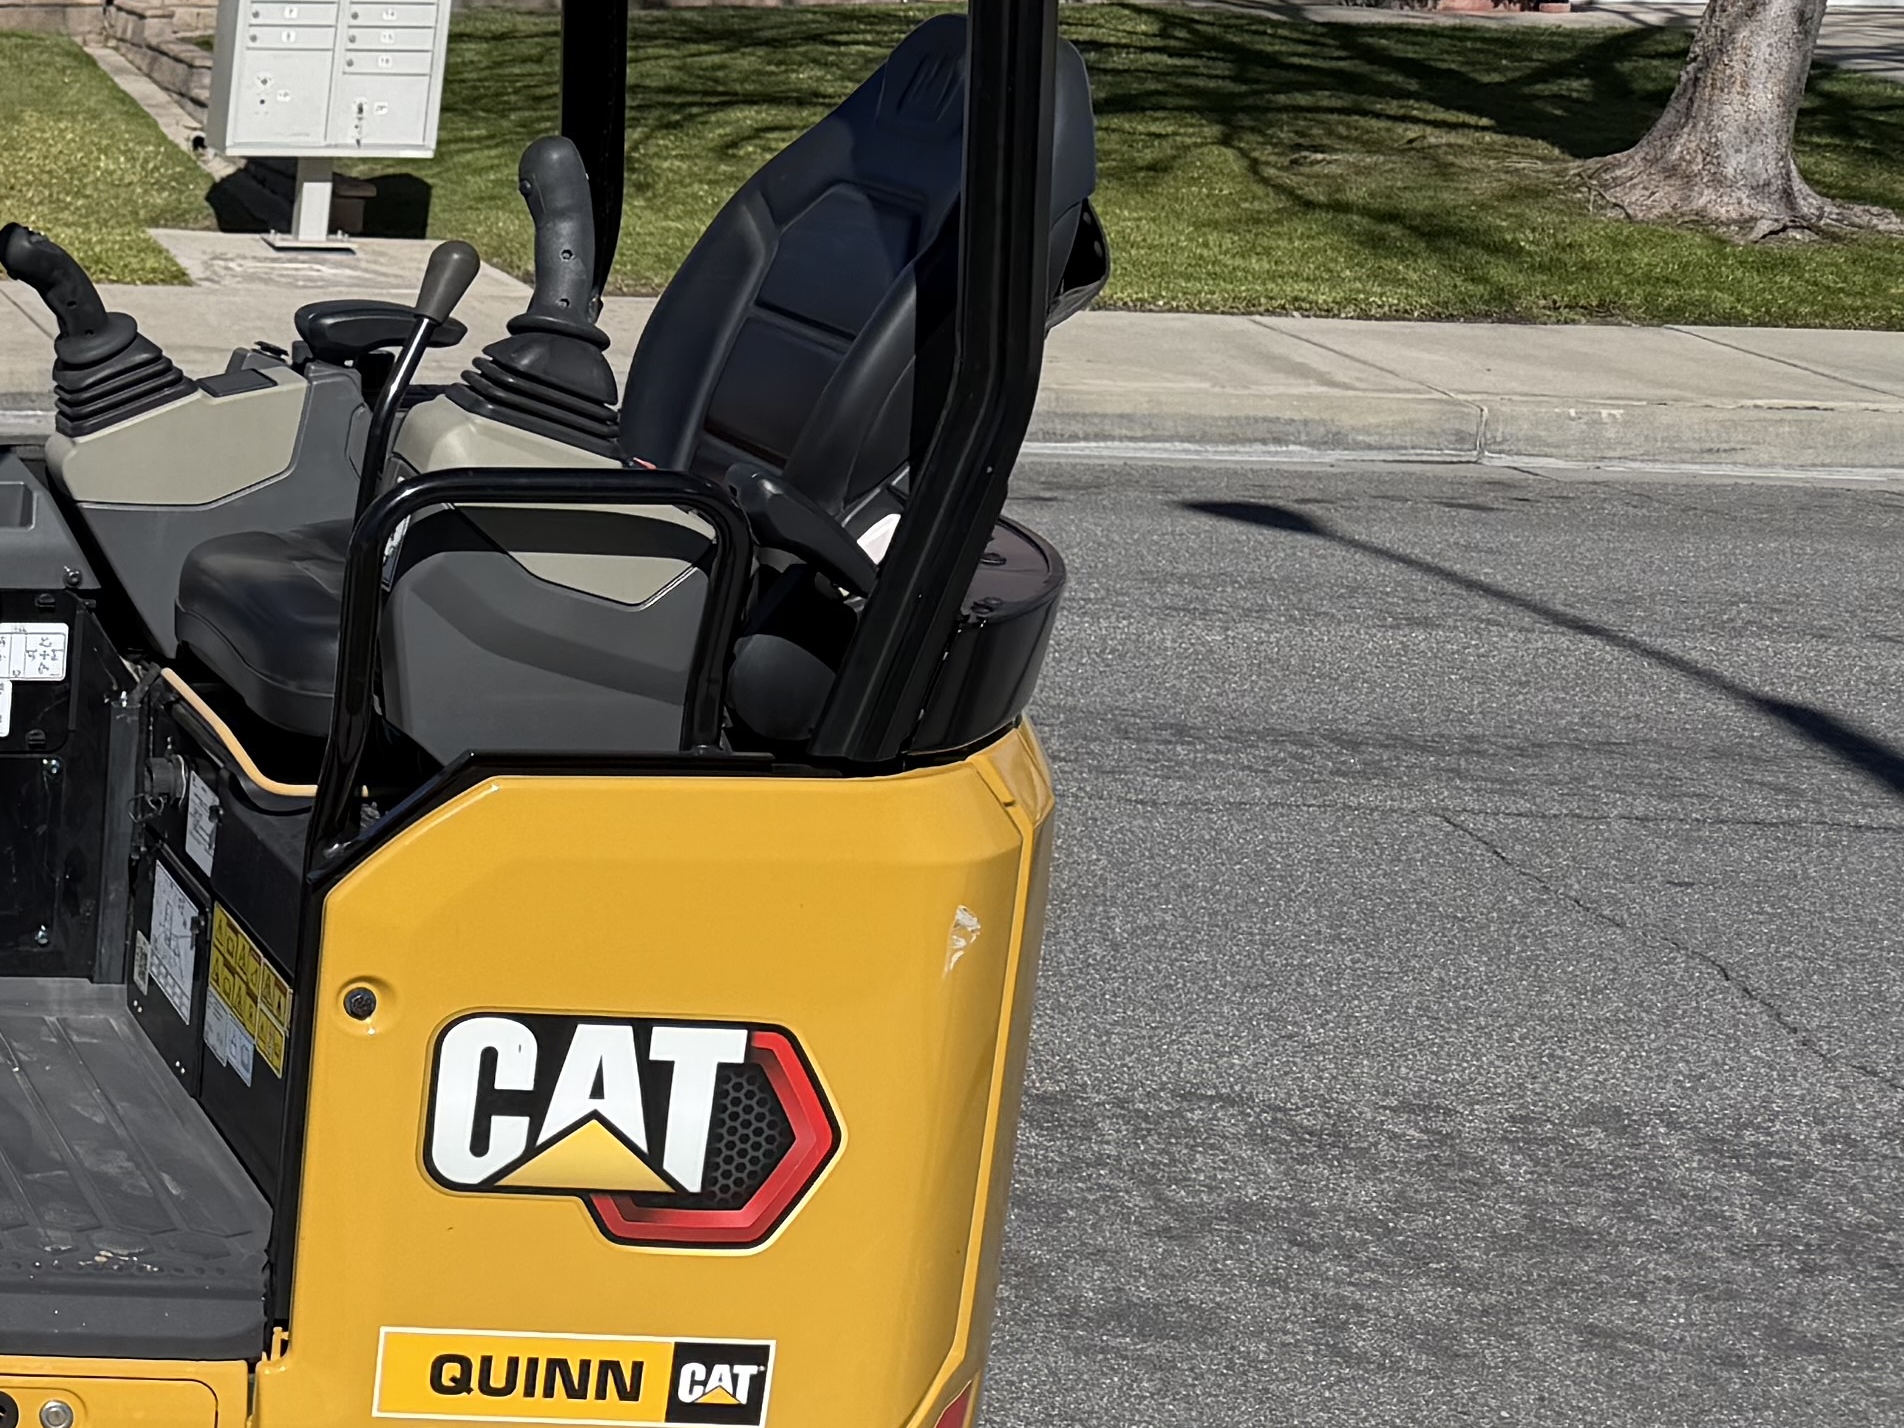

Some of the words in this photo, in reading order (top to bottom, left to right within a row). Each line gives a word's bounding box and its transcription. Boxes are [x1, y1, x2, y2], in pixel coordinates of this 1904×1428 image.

[431, 1017, 749, 1193] CAT
[429, 1353, 644, 1403] QUINN
[677, 1361, 758, 1405] CAT
